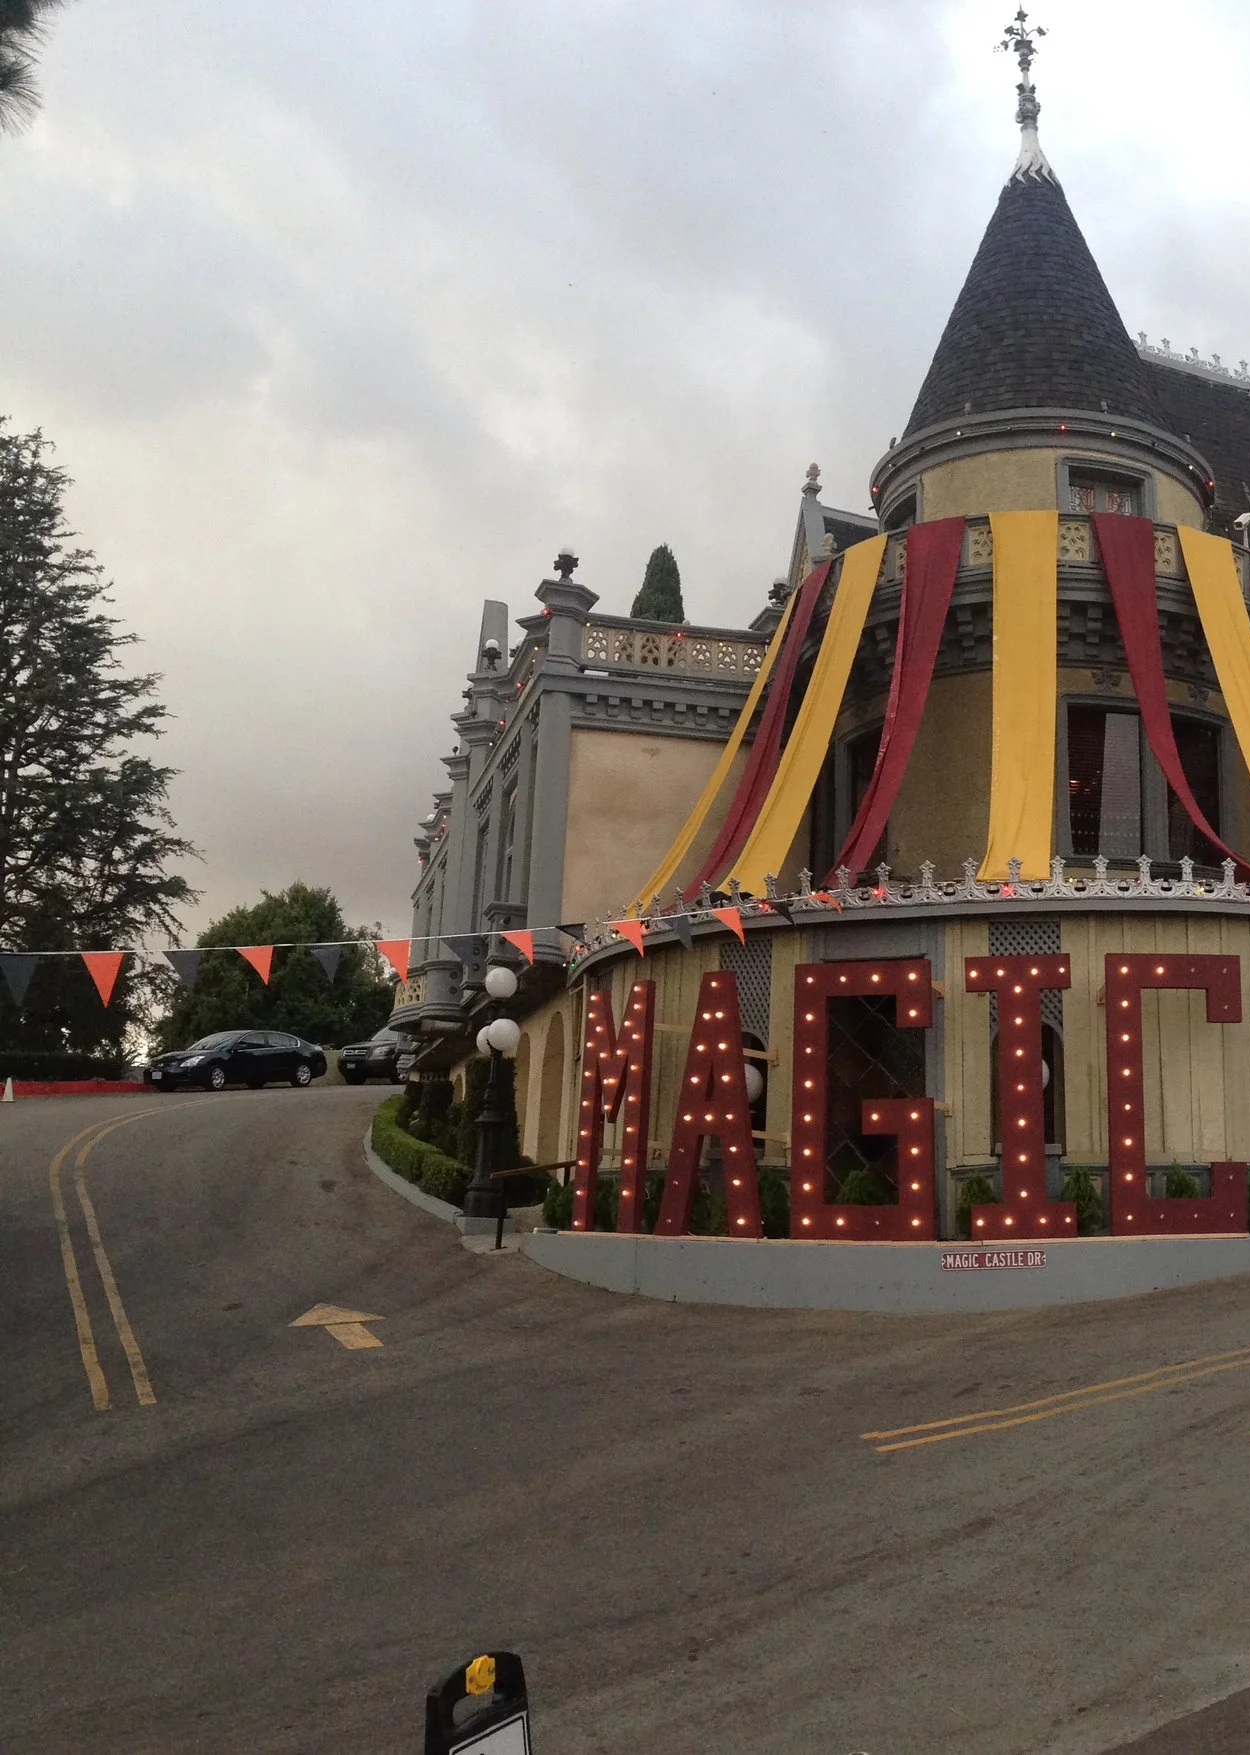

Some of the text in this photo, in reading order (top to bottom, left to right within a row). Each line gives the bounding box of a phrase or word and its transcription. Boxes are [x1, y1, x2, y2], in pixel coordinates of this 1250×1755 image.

[572, 953, 1249, 1239] MAGIC
[946, 1252, 1041, 1268] MAGIC CASTLE DR
